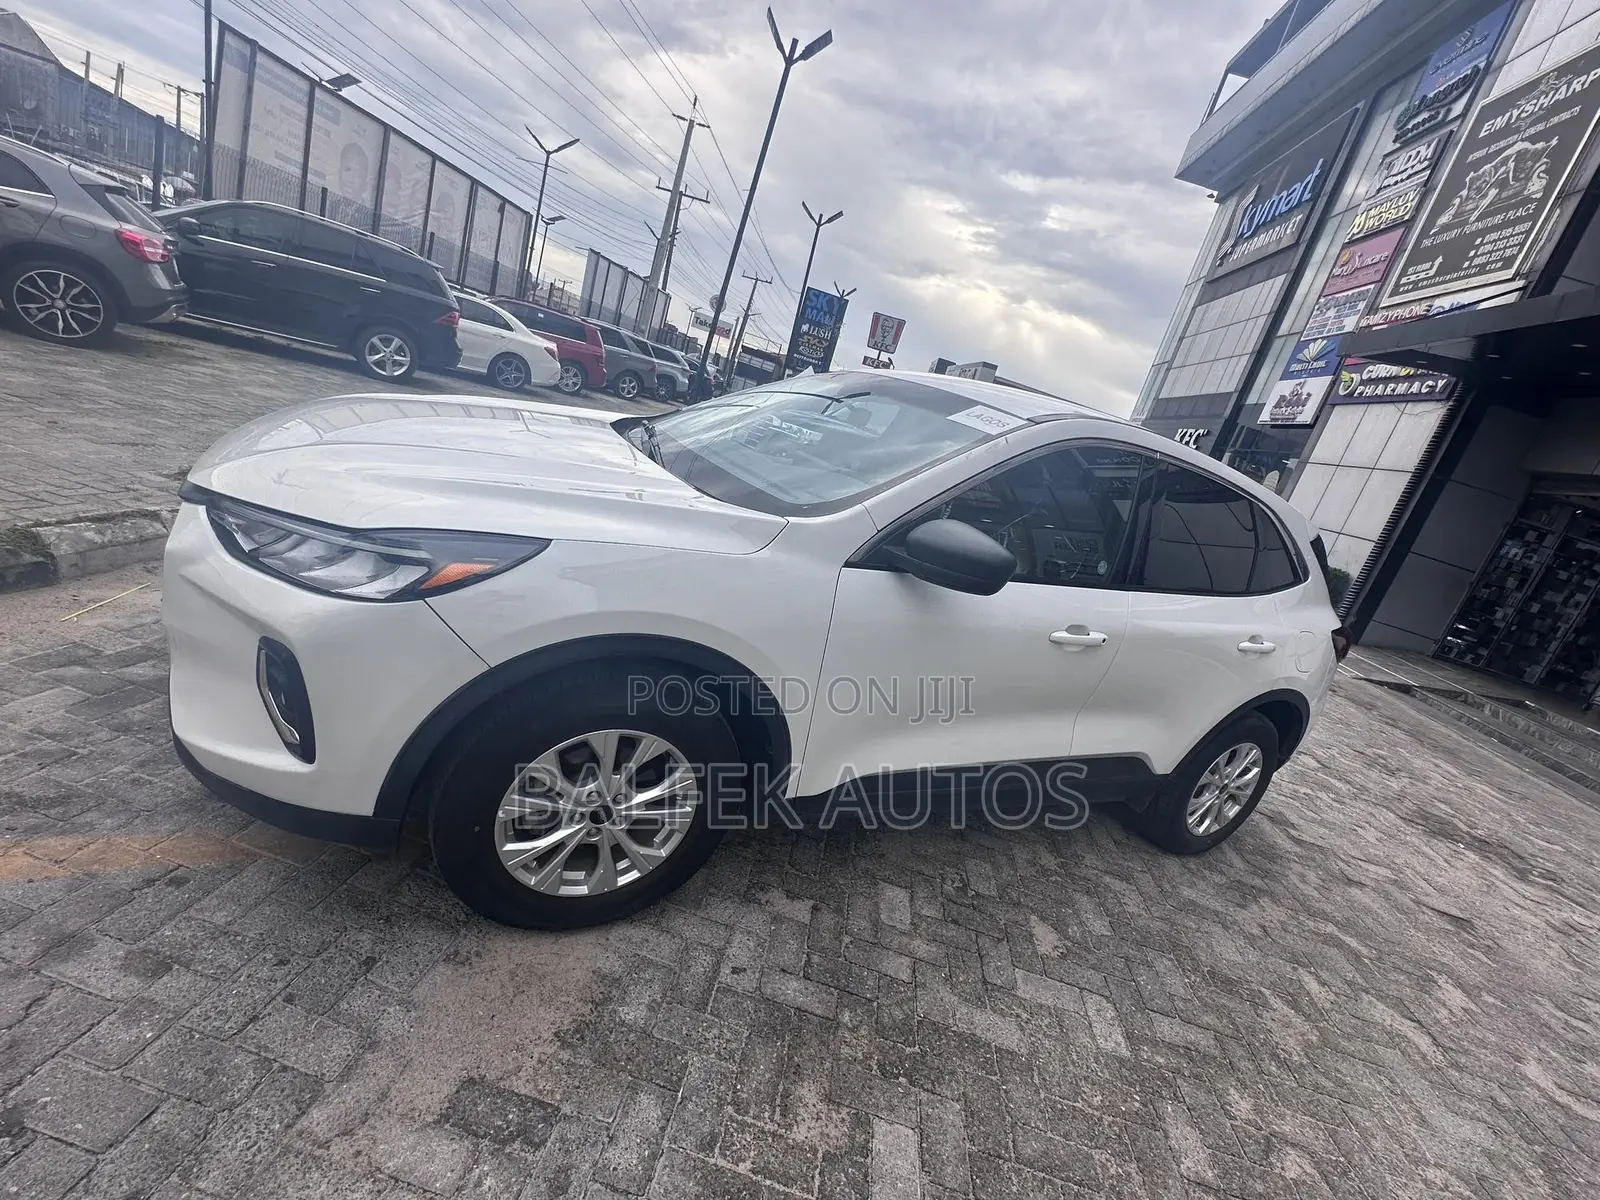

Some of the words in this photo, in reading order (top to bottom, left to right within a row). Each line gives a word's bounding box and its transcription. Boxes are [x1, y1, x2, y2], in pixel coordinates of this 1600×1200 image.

[1478, 67, 1600, 138] EMYSHARP
[1365, 202, 1412, 230] WORLD
[1432, 227, 1463, 245] LUXURY
[1462, 213, 1505, 235] FURNITURE
[1505, 202, 1538, 221] PLACE
[805, 289, 840, 318] SKY
[810, 324, 832, 340] LUSH
[873, 340, 892, 351] KFC
[866, 357, 888, 369] KFC
[1354, 378, 1448, 397] PHARMACY
[965, 410, 1010, 428] LAGOS
[1174, 428, 1205, 449] KFC
